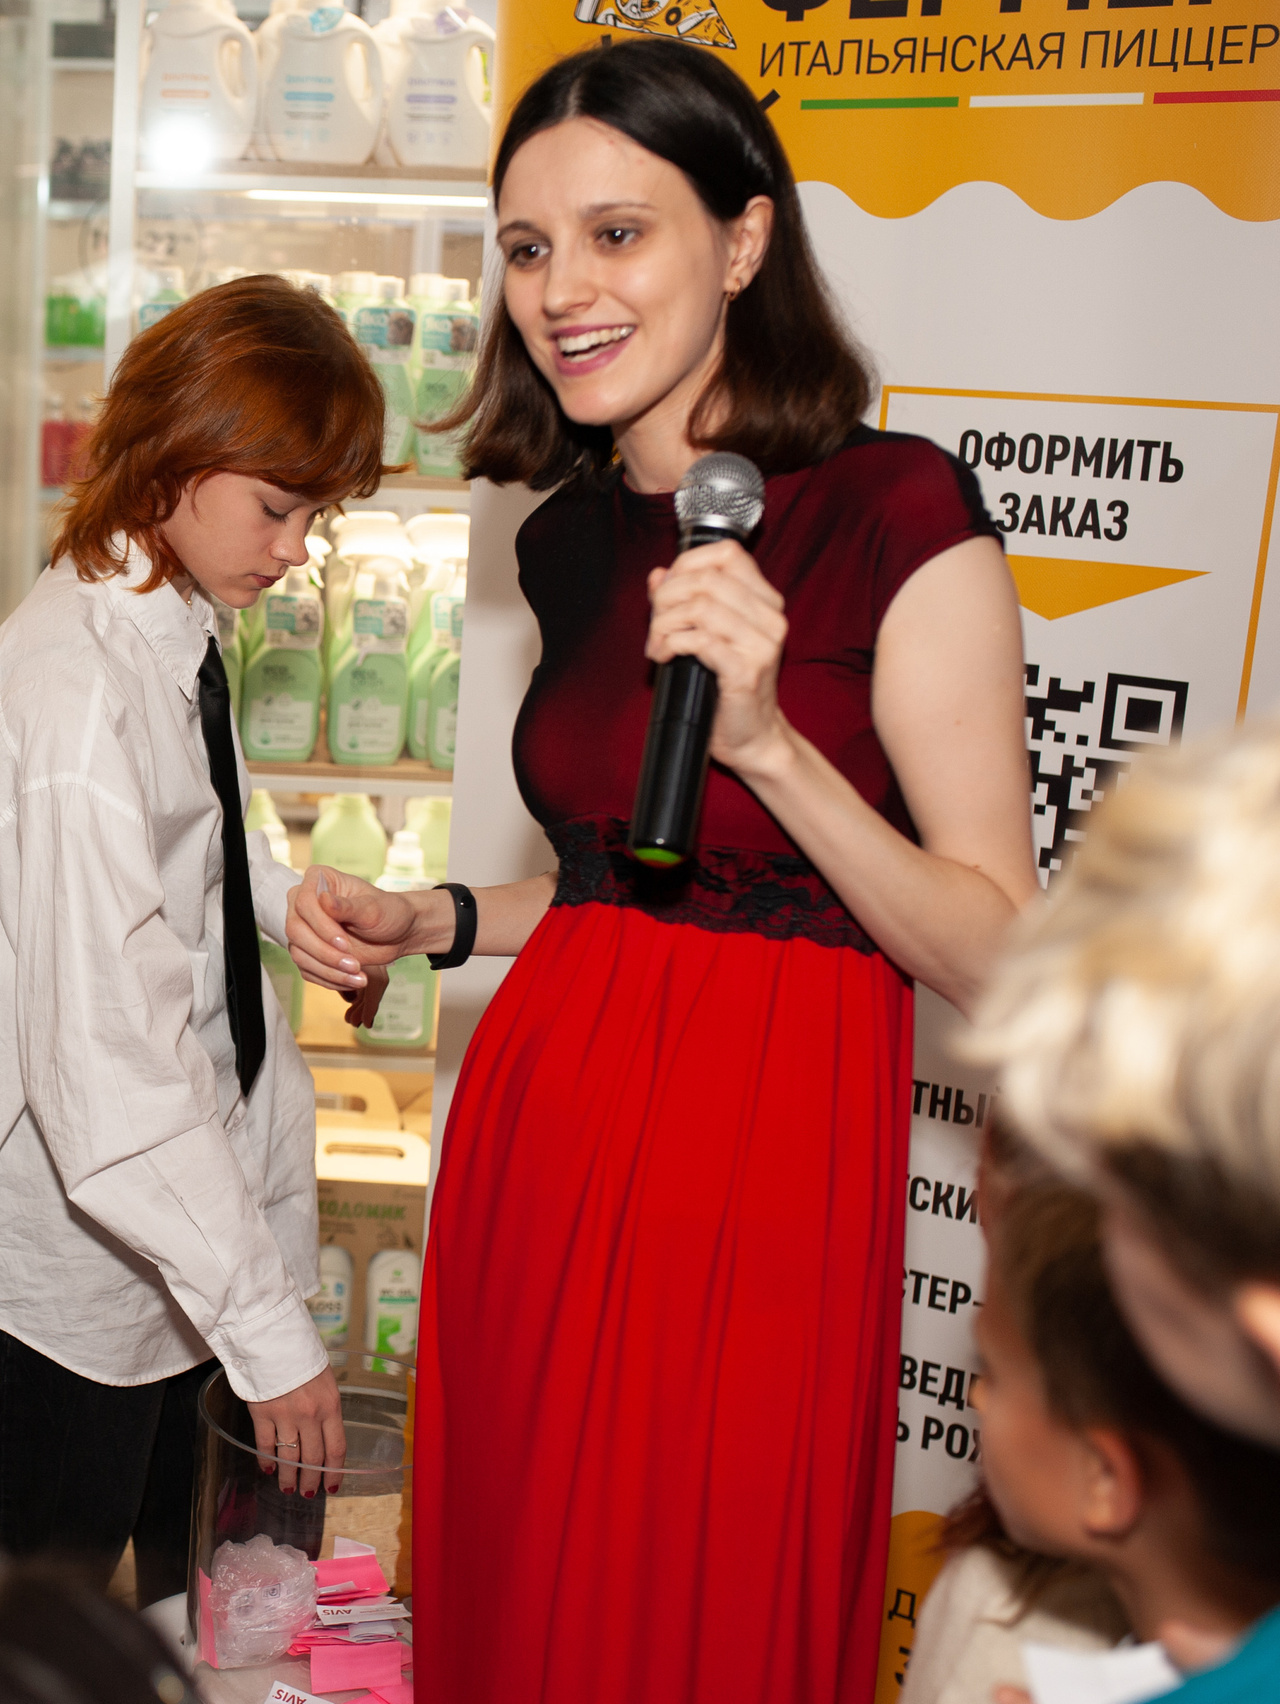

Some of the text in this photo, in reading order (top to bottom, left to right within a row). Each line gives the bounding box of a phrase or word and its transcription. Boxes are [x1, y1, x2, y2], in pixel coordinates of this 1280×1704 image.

[759, 23, 1280, 78] ИТАЛЬЯНСКАЯ ПИЦЦЕР
[957, 429, 1185, 484] ОФОРМИТЬ
[995, 492, 1130, 542] ЗАКАЗ
[321, 1608, 352, 1616] AVIS
